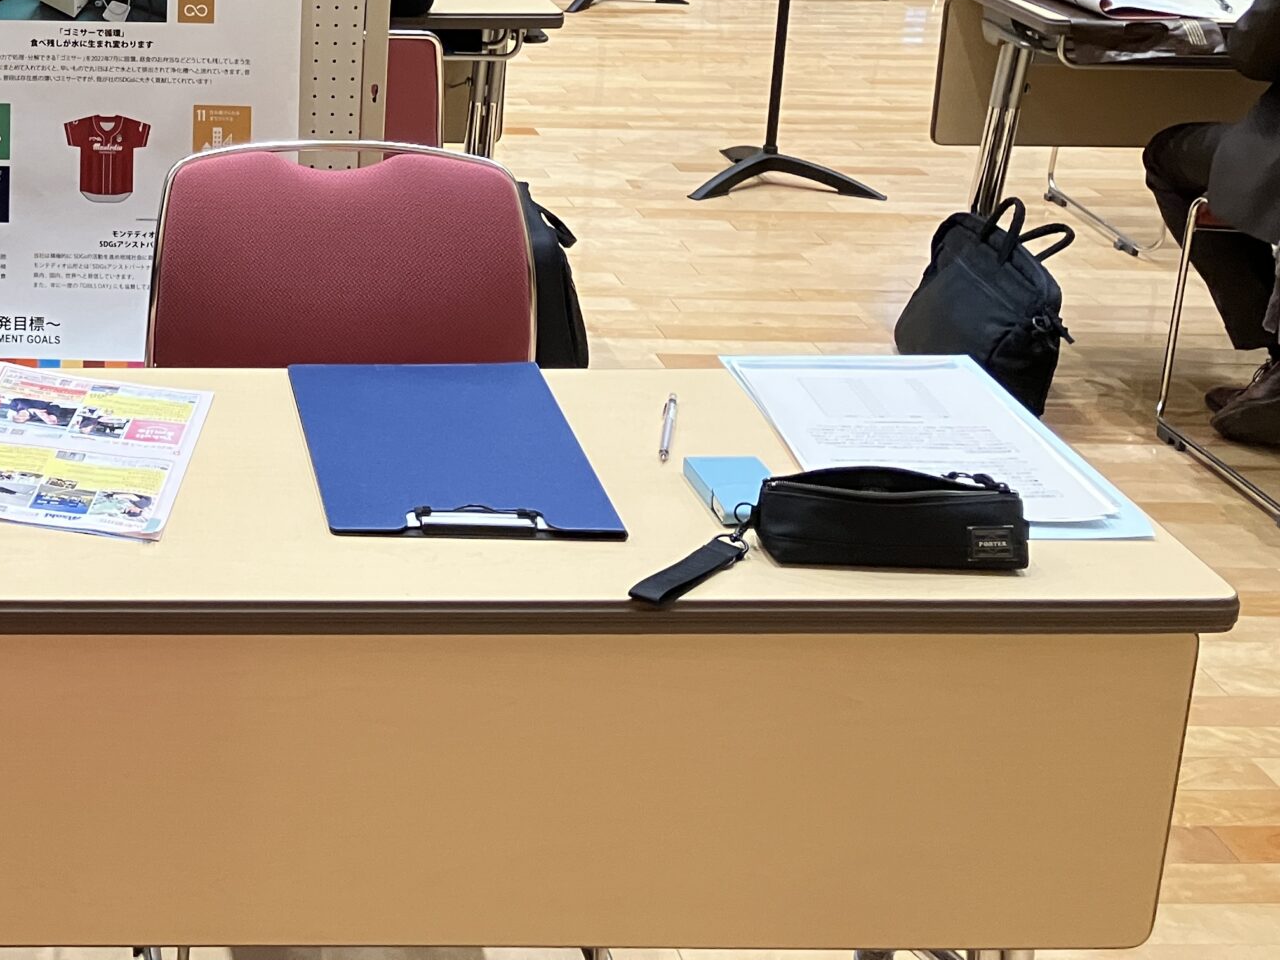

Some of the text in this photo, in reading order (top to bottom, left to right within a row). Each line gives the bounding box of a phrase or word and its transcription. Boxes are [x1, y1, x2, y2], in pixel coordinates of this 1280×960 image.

[59, 28, 124, 37] 「ゴミサーで循環」
[30, 38, 154, 48] 食べ残しが水に生まれ変わります
[196, 110, 206, 122] 11
[26, 334, 60, 344] GOALS
